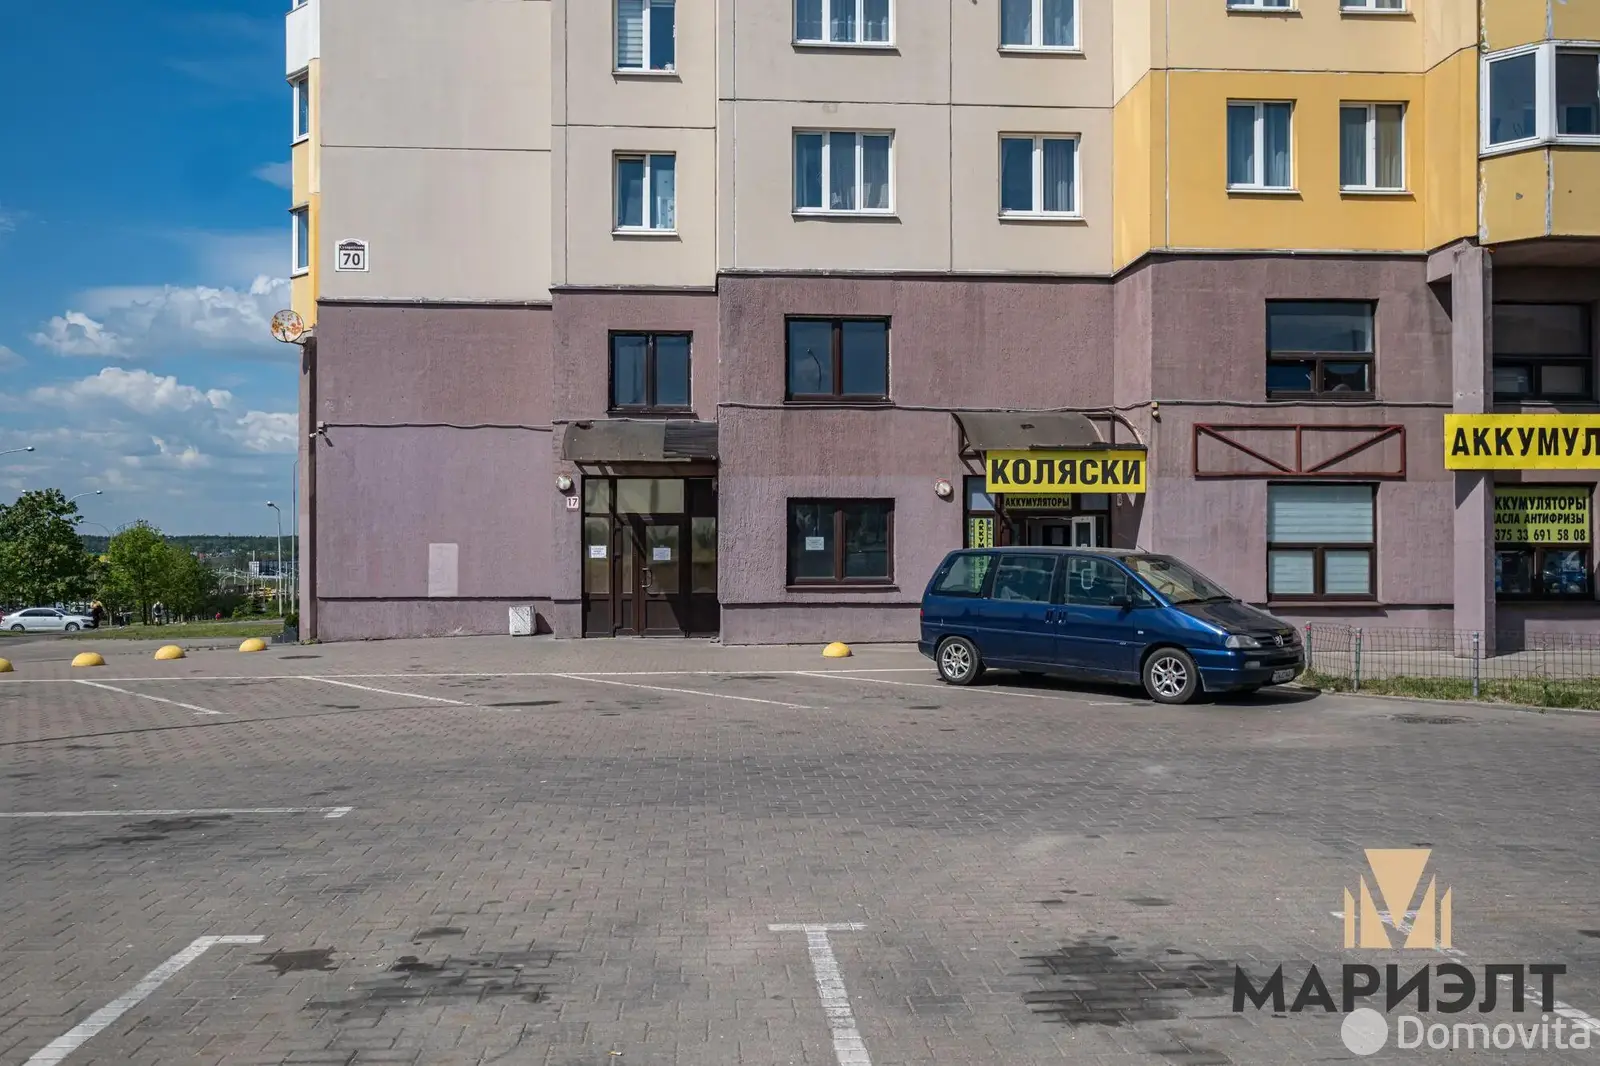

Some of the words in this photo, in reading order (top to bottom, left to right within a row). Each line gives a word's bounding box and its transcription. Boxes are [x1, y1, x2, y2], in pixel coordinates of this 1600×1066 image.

[343, 253, 361, 266] 70
[1451, 427, 1600, 456] АККУМУЛ
[991, 458, 1141, 485] КОЛЯСКИ
[568, 497, 578, 507] 17
[1004, 497, 1070, 508] АККУМУЛЯТОРЫ
[1494, 496, 1587, 511] ККУМУЛЯТОРЫ
[1494, 513, 1520, 525] АСЛА
[1524, 512, 1585, 525] АНТИФРИЗЫ
[1517, 529, 1529, 541] 33
[1533, 529, 1551, 541] 691
[1557, 529, 1569, 541] 58
[1573, 529, 1586, 541] 08
